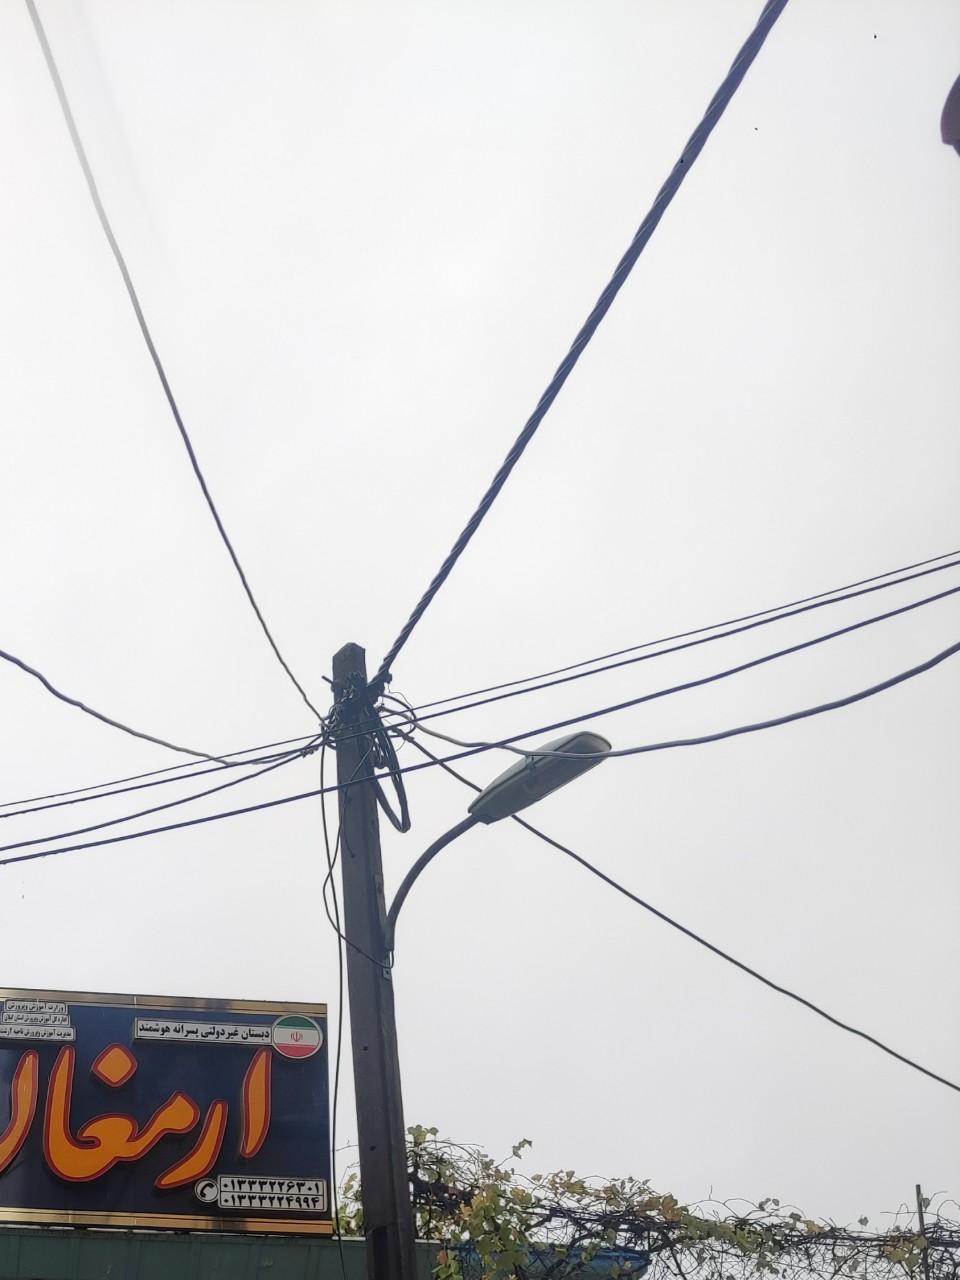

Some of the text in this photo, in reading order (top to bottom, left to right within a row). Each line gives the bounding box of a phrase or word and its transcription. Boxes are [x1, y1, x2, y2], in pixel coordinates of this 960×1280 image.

[139, 1023, 171, 1035] هوشمند
[173, 1024, 199, 1037] پسرانه
[241, 1027, 270, 1041] دبستان
[223, 1179, 320, 1194] ۰۱۳۳۳۲۲۶۳۰۱
[223, 1194, 320, 1209] ۰۱۳۳۳۲۲۴۹۹۴
